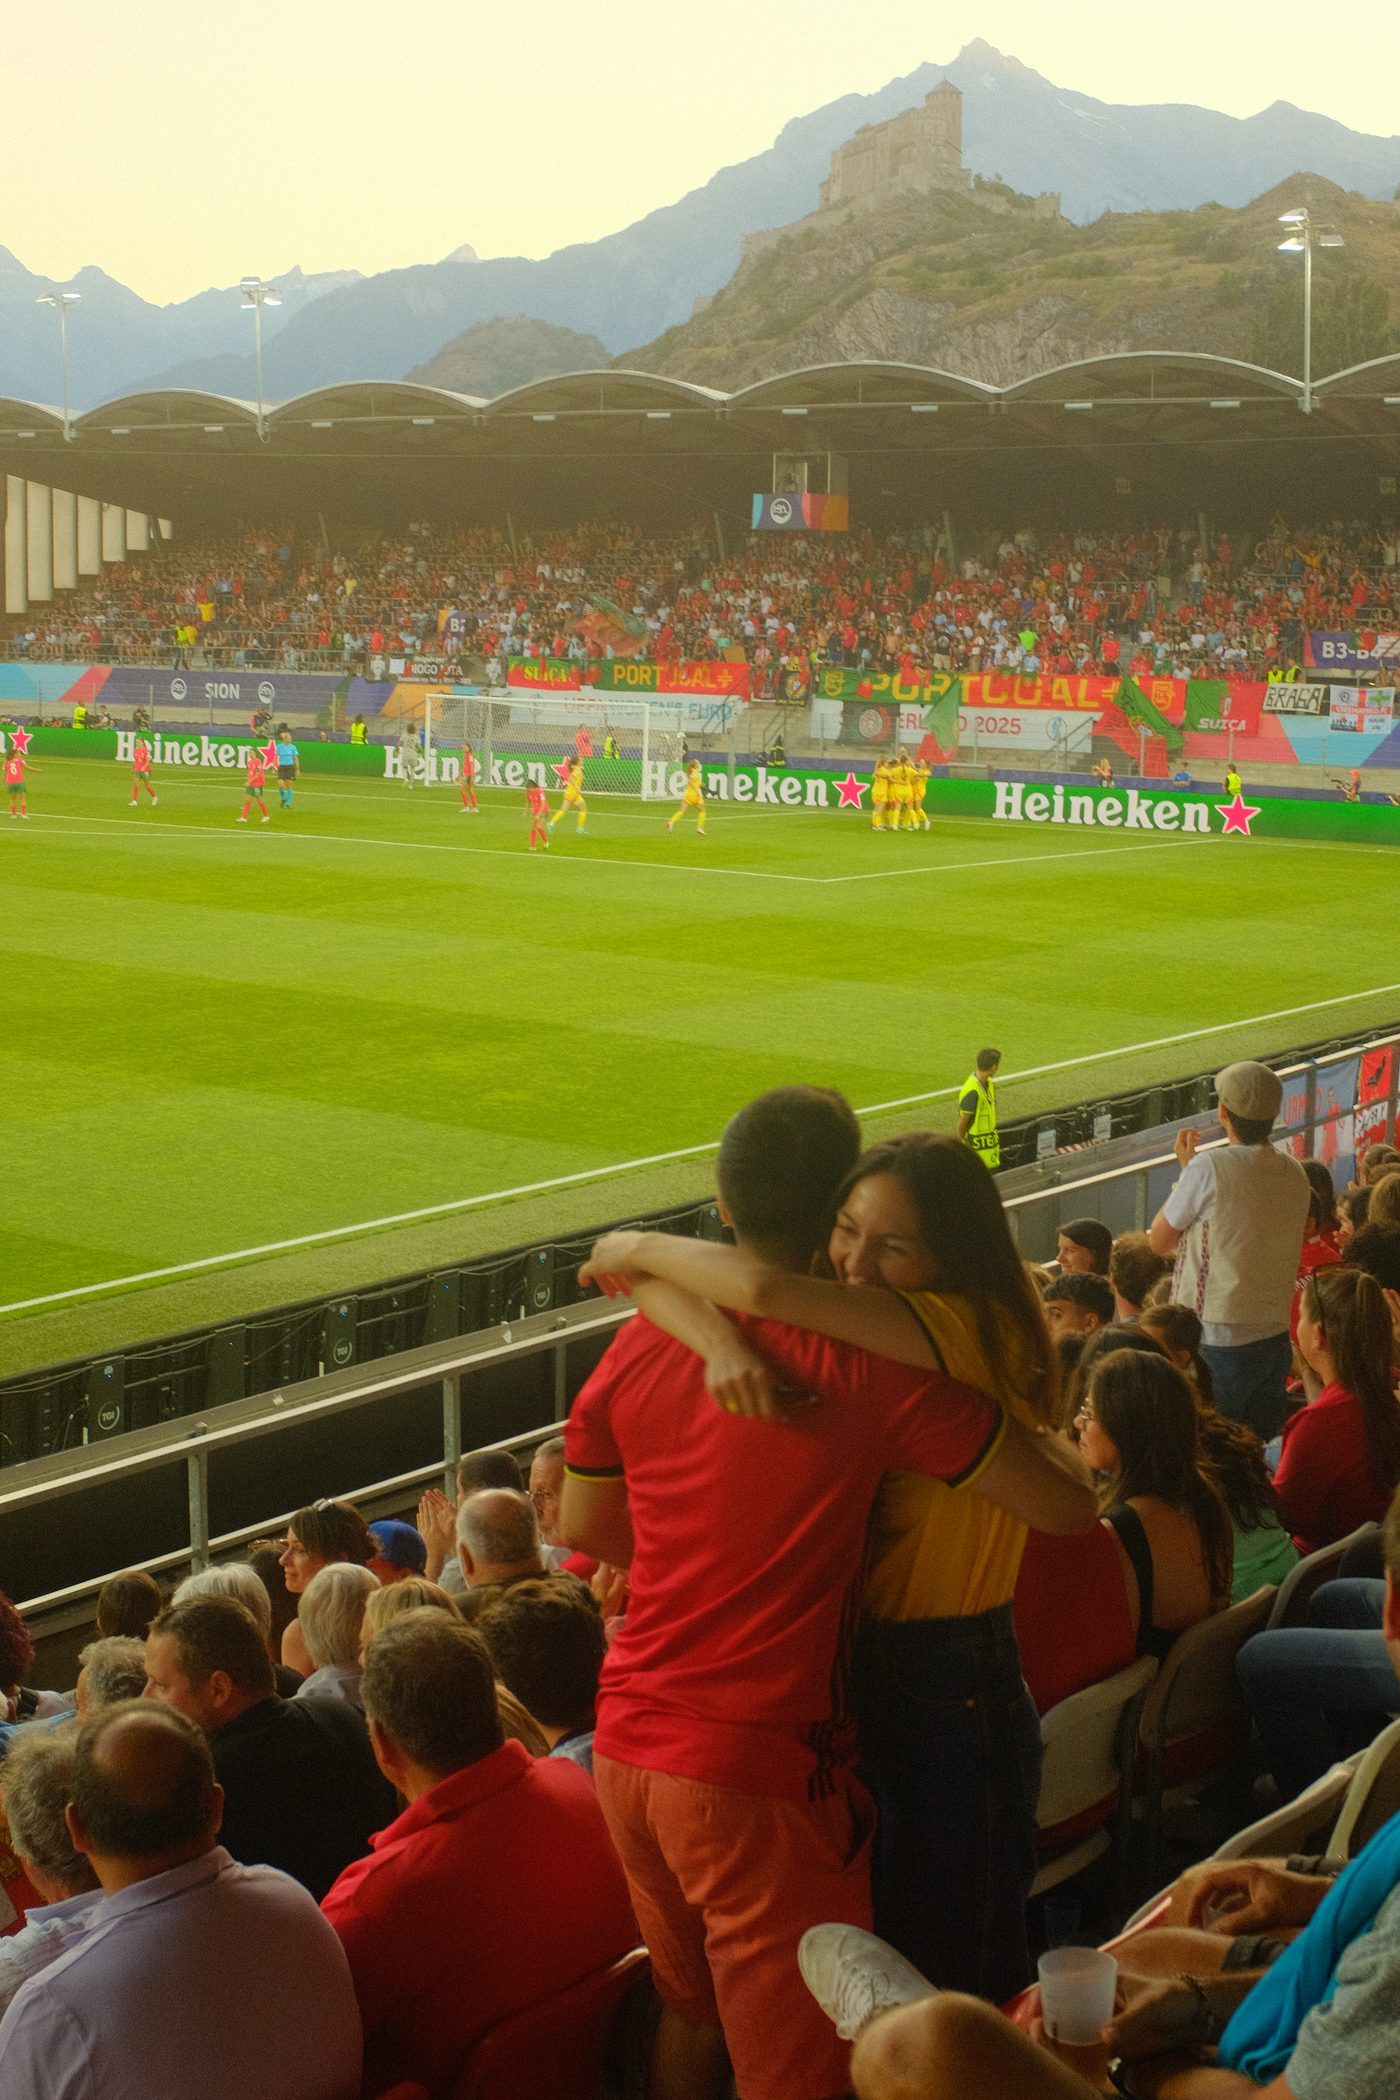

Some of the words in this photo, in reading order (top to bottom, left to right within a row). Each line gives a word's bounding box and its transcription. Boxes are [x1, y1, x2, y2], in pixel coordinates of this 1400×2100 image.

[204, 683, 240, 699] SION
[974, 716, 1022, 735] 2025
[646, 760, 830, 807] Heneken
[992, 781, 1212, 833] Heineken
